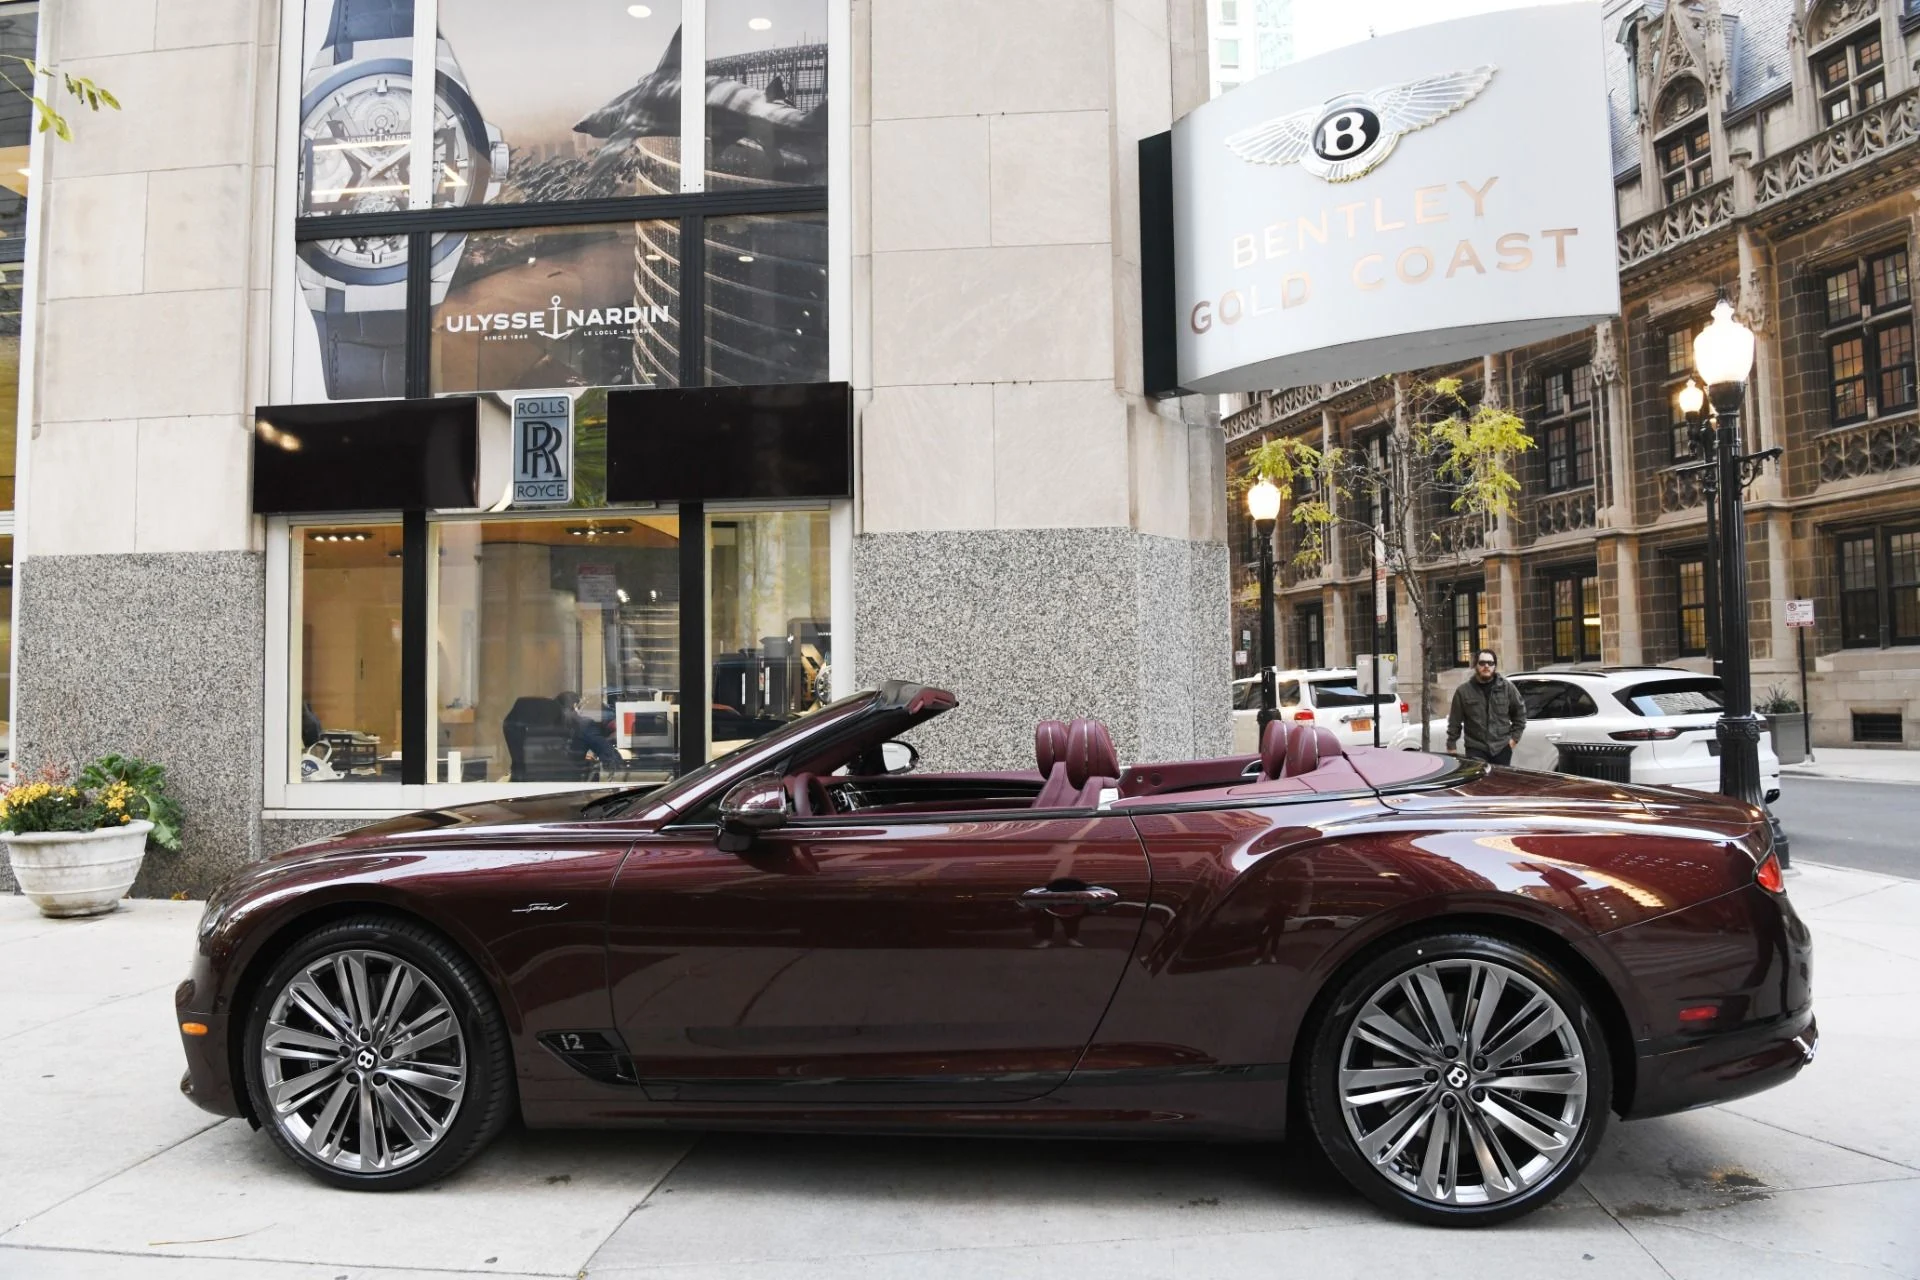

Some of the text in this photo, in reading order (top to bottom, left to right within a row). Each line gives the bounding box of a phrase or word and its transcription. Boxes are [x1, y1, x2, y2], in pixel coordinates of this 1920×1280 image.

[1323, 111, 1368, 157] B
[1232, 176, 1500, 270] BENTLEY
[1190, 228, 1579, 335] GOLD COAST
[446, 305, 669, 333] ULYSSE NARDIN
[518, 401, 565, 415] ROLLS
[517, 484, 565, 498] ROYCE
[560, 1033, 584, 1050] 12
